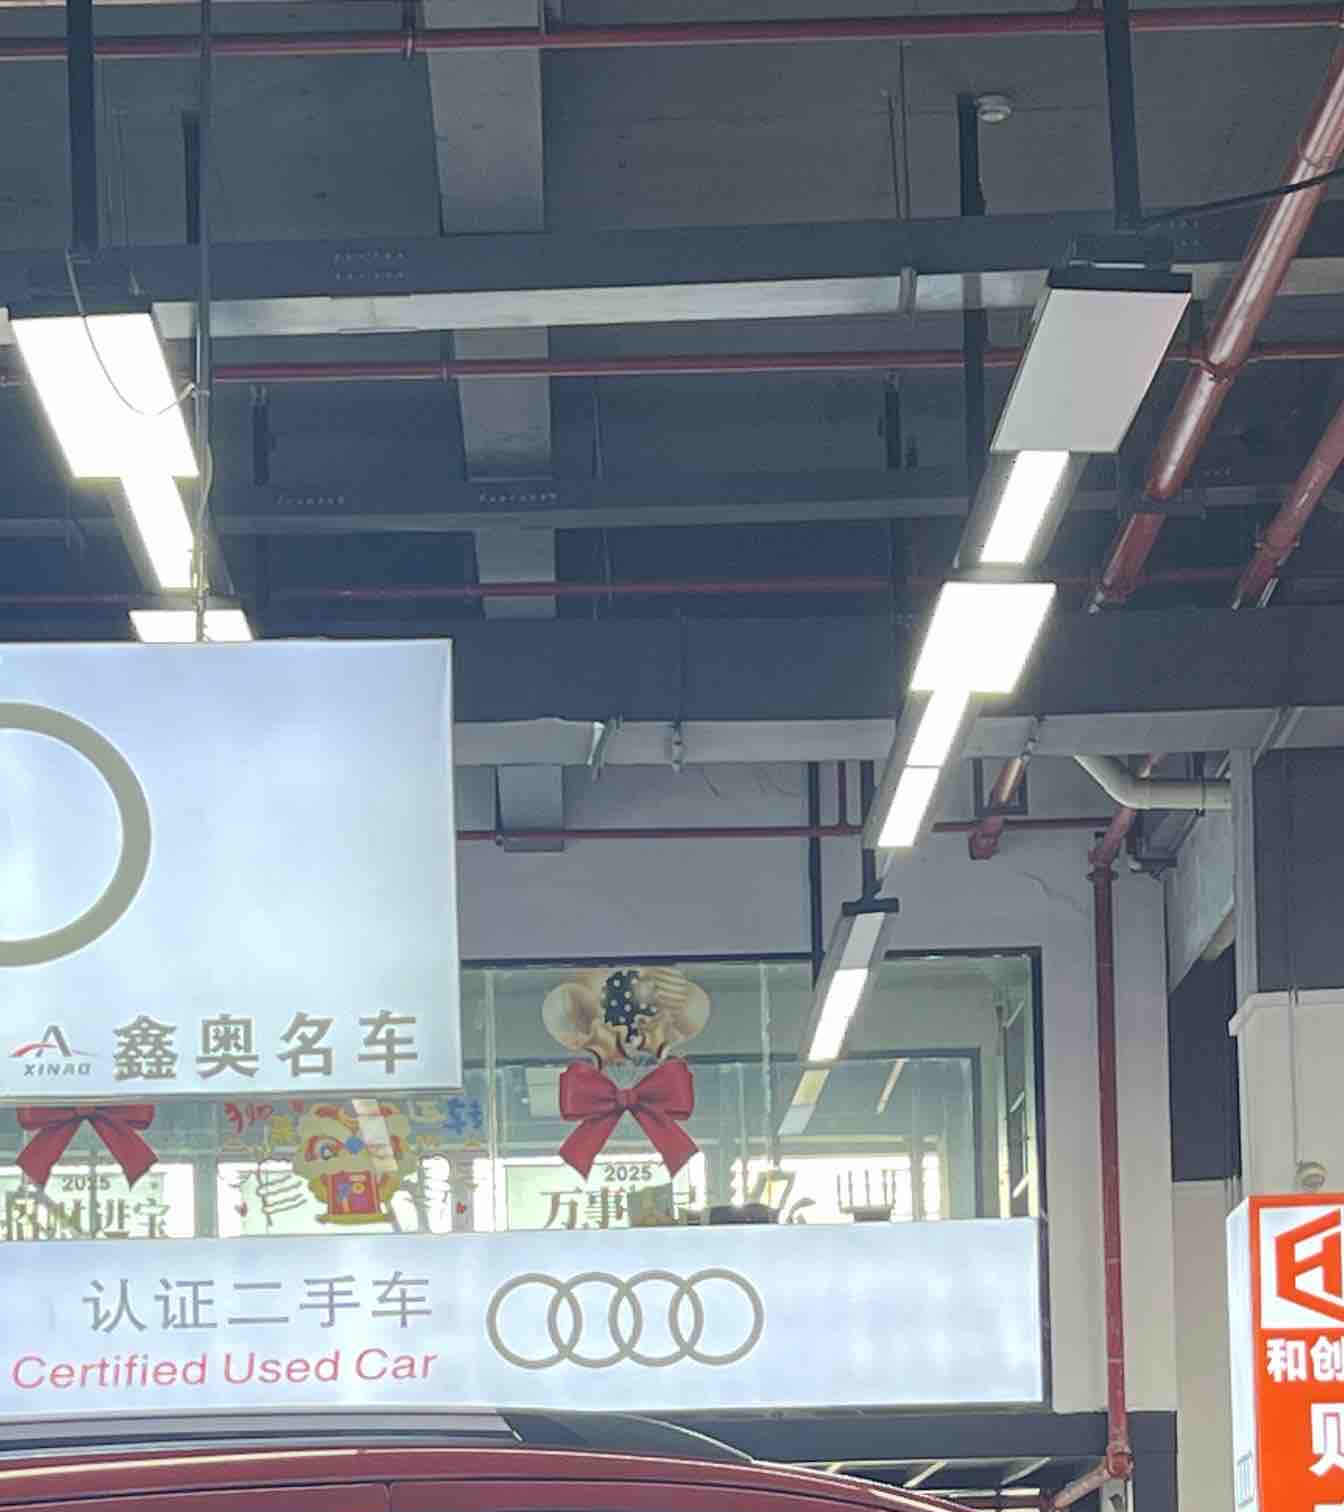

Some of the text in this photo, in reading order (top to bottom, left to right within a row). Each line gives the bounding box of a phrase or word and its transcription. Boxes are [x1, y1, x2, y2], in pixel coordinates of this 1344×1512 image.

[112, 1010, 419, 1081] 鑫奥名车
[23, 1063, 92, 1077] XINAO
[62, 1176, 111, 1191] 2025
[604, 1165, 652, 1181] 2025
[82, 1271, 433, 1333] 认证二手车
[10, 1353, 208, 1389] Certified
[222, 1349, 342, 1386] Used
[355, 1347, 437, 1380] Car
